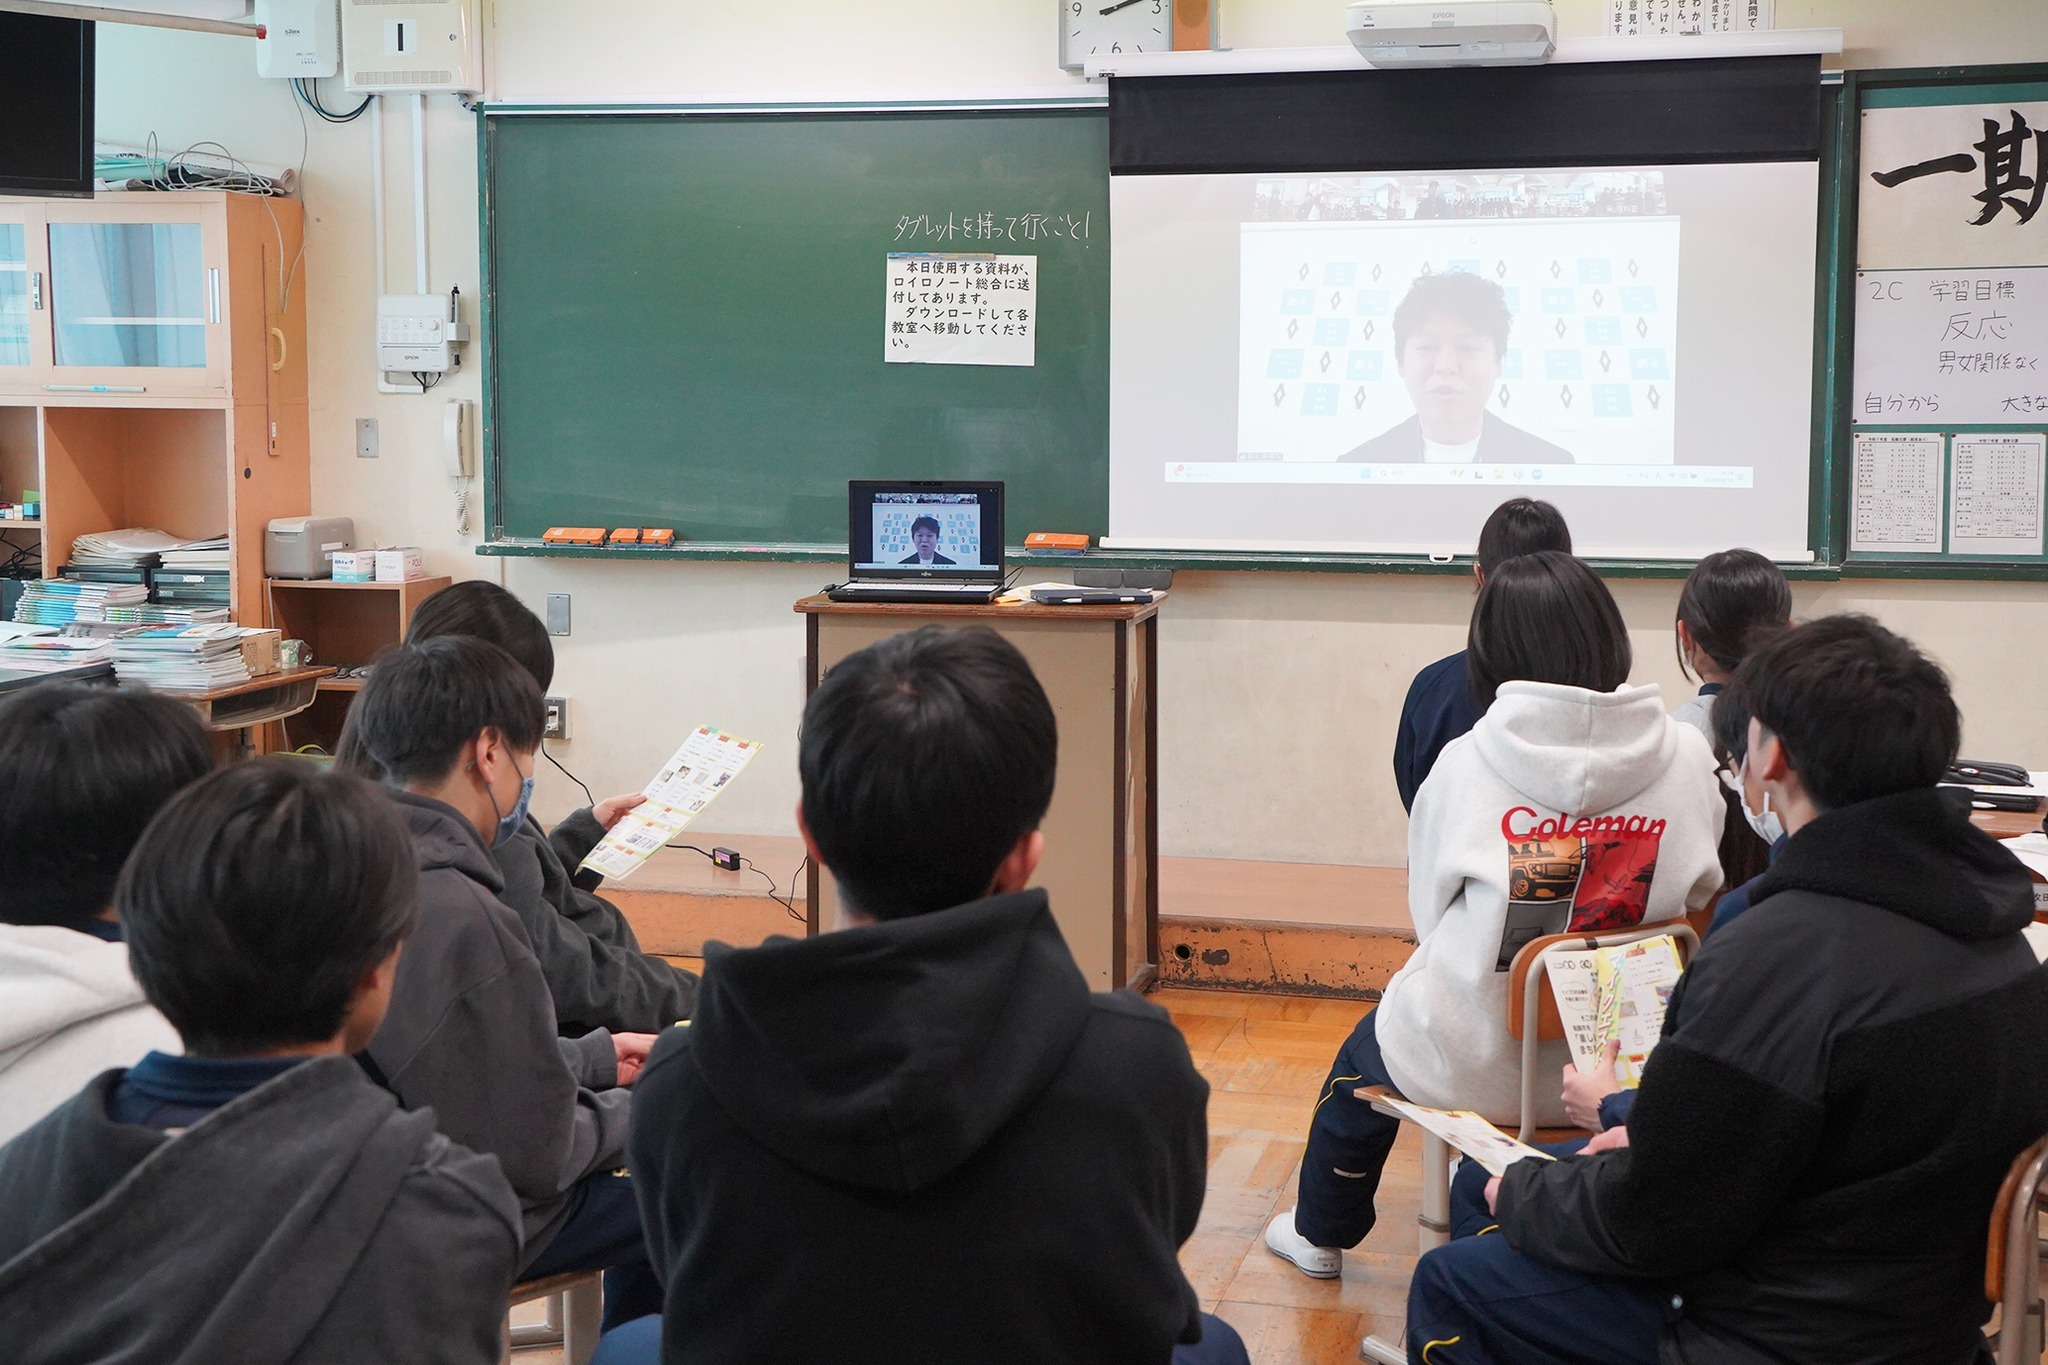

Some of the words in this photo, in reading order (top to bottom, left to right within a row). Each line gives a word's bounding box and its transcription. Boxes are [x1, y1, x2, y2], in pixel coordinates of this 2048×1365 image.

[1072, 2, 1082, 17] 9
[1151, 0, 1161, 15] 3
[1111, 41, 1122, 54] 6
[906, 262, 1030, 275] 本日使用する資料が、
[894, 277, 1030, 291] ロイロノート総合に送
[1869, 281, 1903, 300] 2C
[1929, 279, 2015, 301] 学習目標
[892, 292, 988, 305] 付してあります。
[905, 306, 1029, 321] ダウンロードして各
[892, 321, 1028, 336] 教室へ移動してくださ
[1941, 310, 2013, 342] 反応
[892, 337, 910, 349] い。
[1938, 350, 2037, 375] 男女関係なく
[1865, 391, 1939, 414] 自分から
[1501, 805, 1667, 845] Coleman
